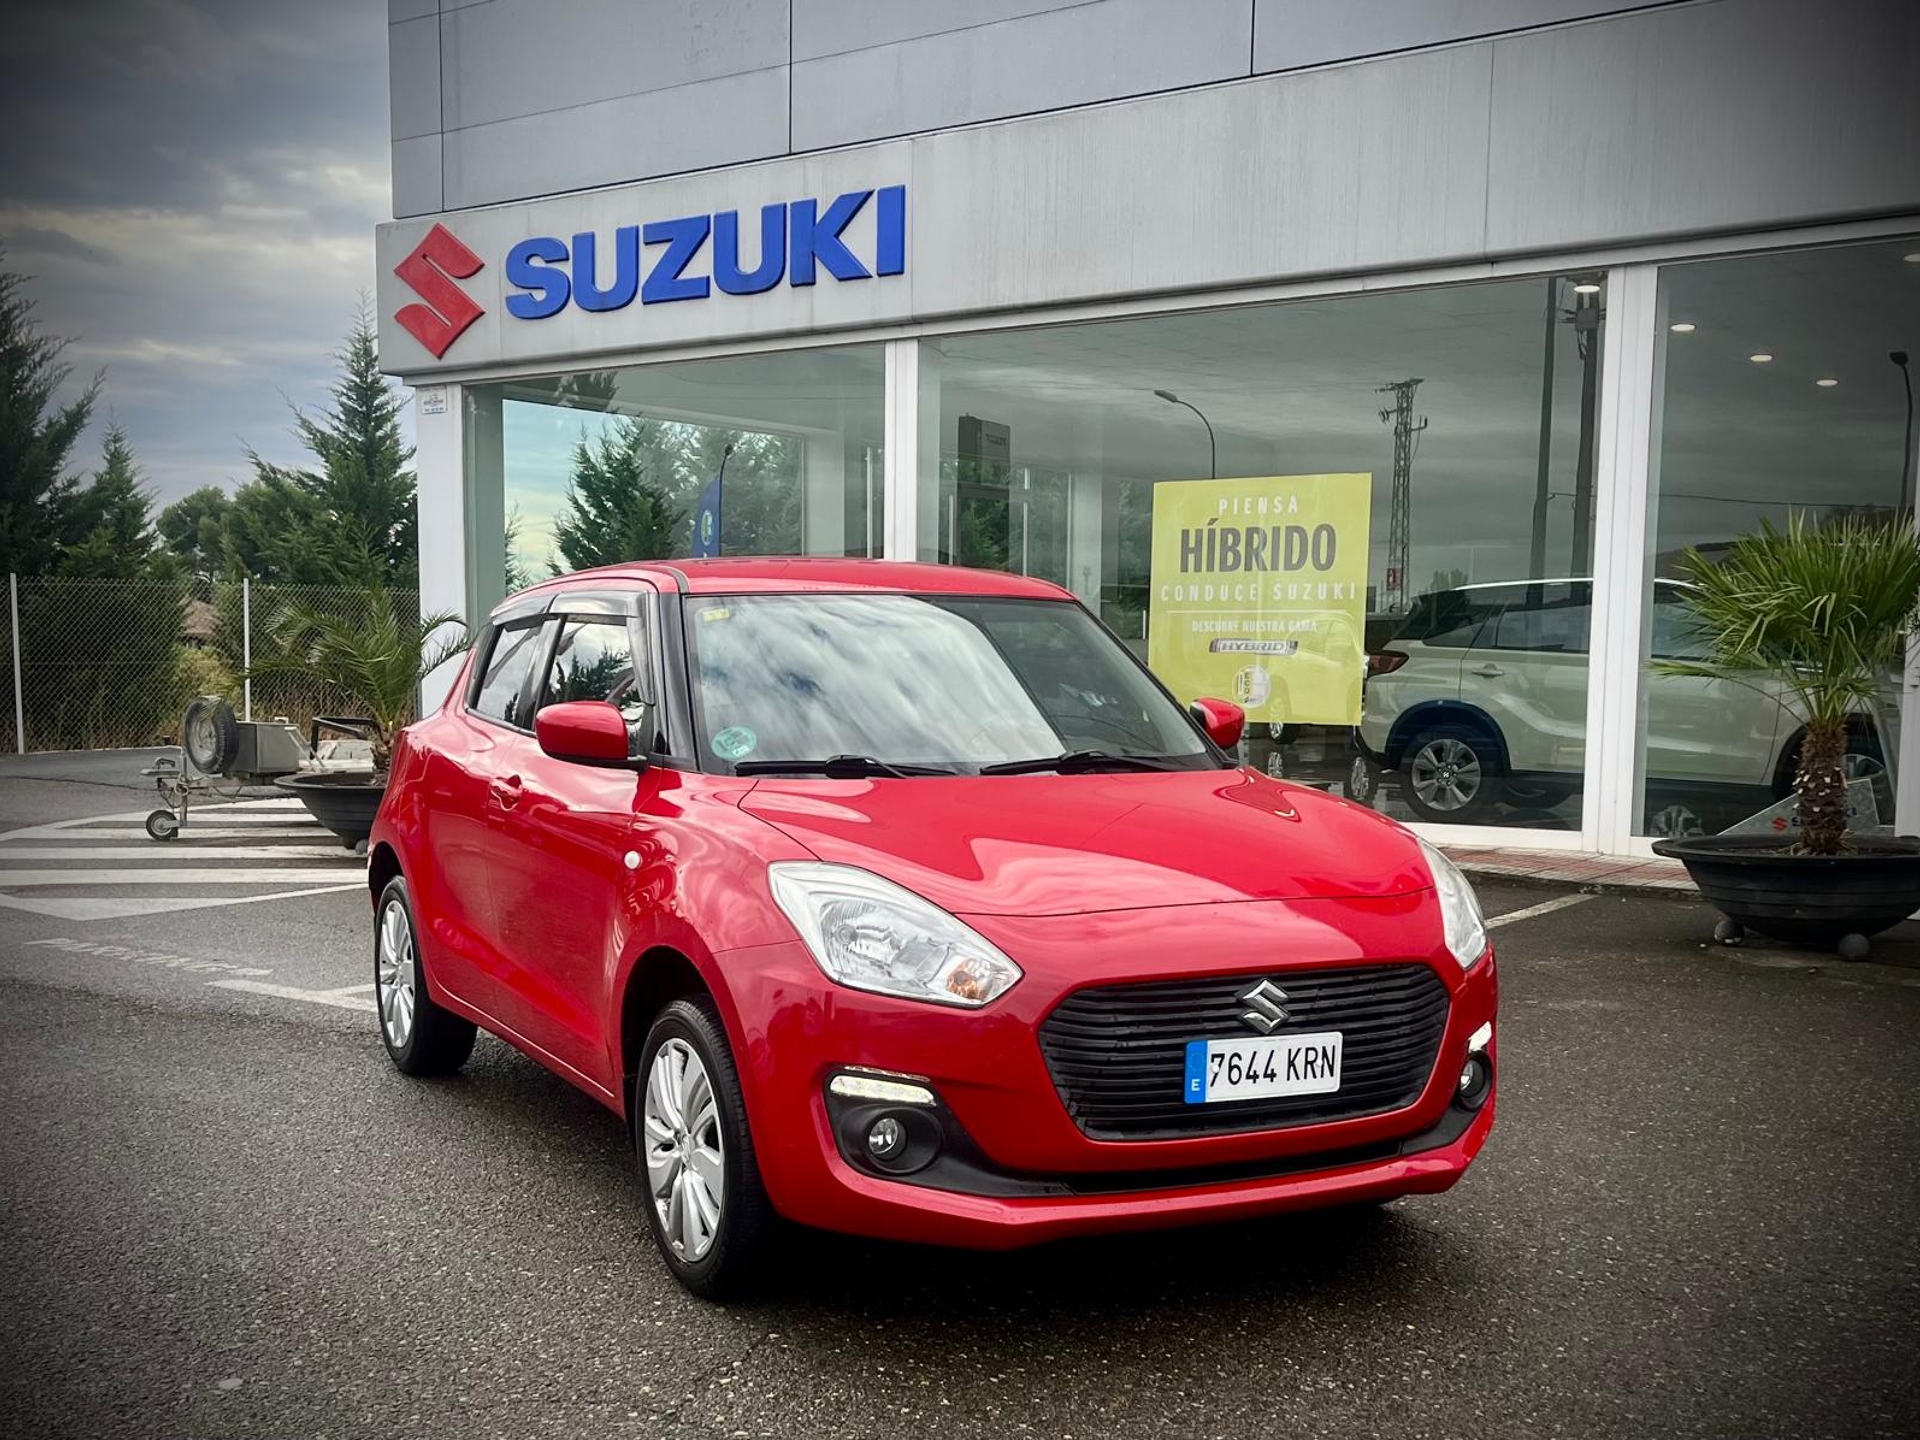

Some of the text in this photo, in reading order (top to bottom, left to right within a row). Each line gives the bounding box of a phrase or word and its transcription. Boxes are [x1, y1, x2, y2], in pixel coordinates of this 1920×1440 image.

[505, 184, 906, 319] SUZUKI
[1219, 496, 1299, 515] PIENSA
[1180, 518, 1336, 573] HÍBRIDO
[1161, 582, 1356, 601] CONDUCE SUZUKI
[1192, 620, 1238, 632] DESCUBRE
[1243, 620, 1285, 632] NUESTRA
[1221, 641, 1286, 652] HYBRID
[1210, 1045, 1336, 1087] 7644 KRN
[1191, 1079, 1200, 1091] E
